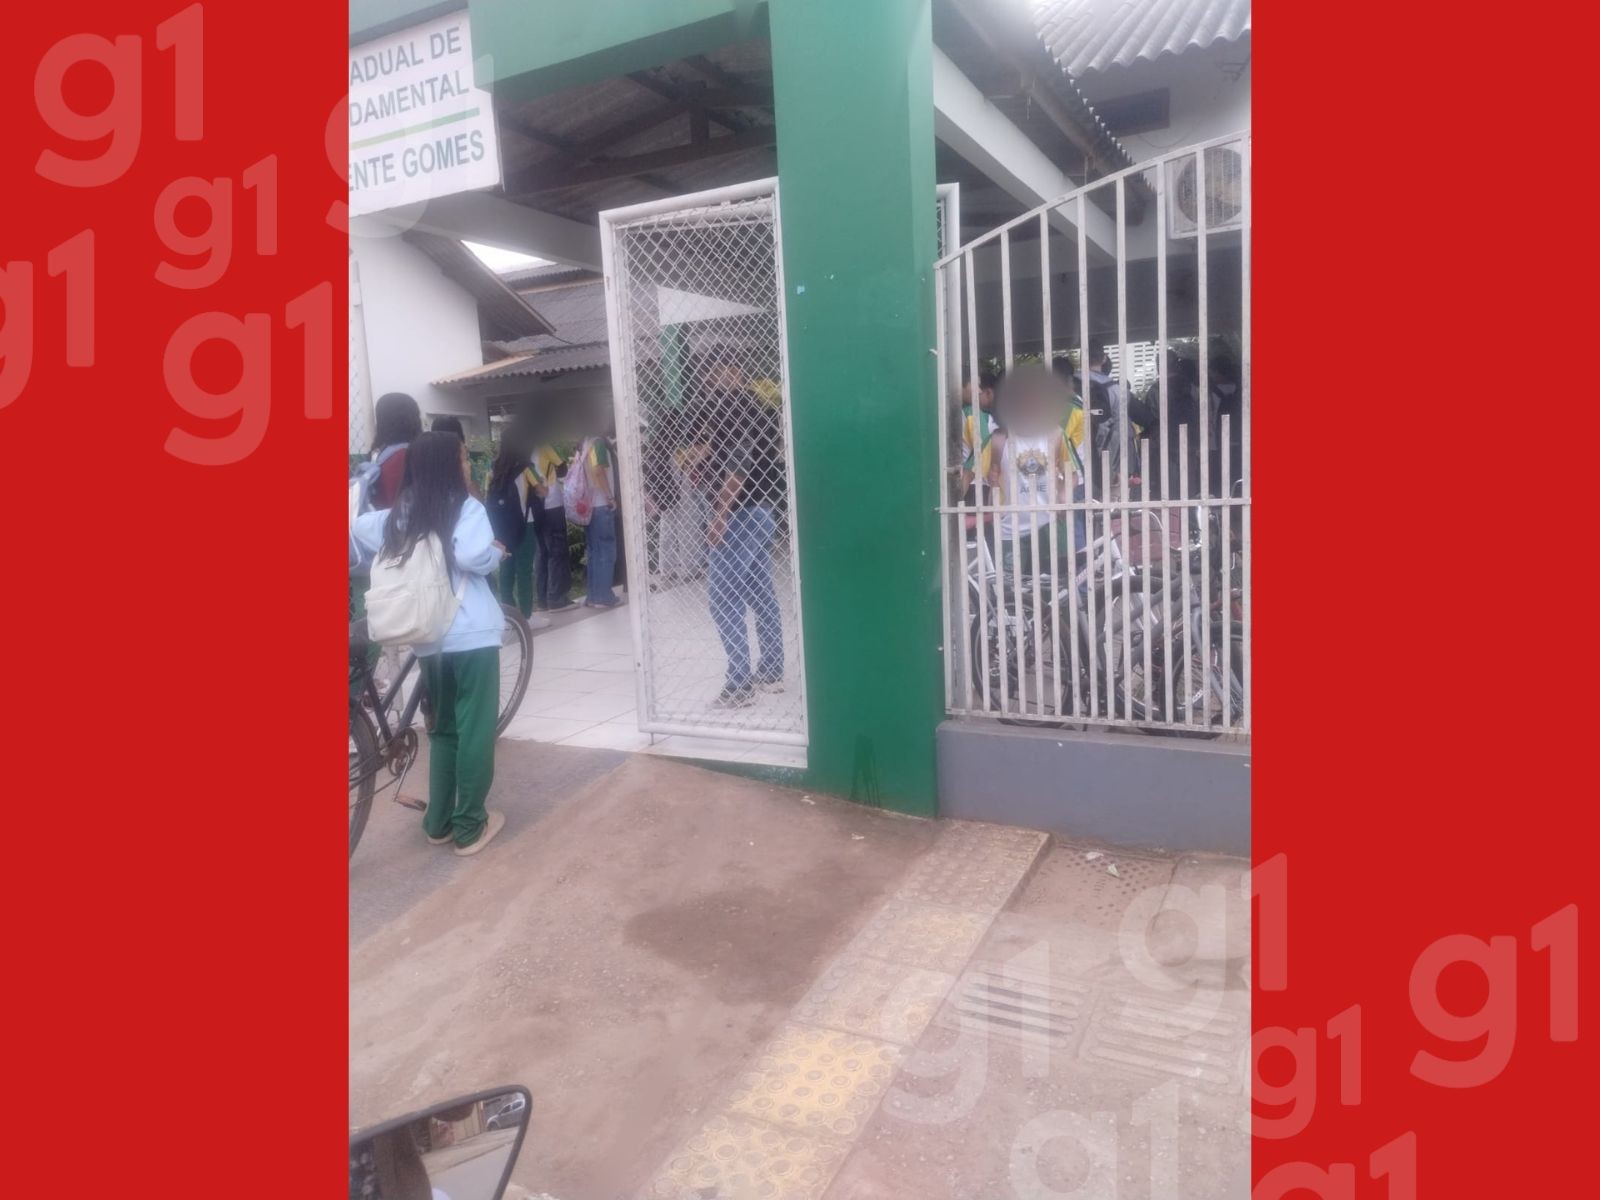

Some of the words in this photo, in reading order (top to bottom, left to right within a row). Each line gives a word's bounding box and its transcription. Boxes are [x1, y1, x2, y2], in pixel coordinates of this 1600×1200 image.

[350, 41, 424, 86] ADUAL
[430, 26, 462, 59] DE
[349, 70, 470, 127] DAMENTAL
[402, 129, 484, 178] GOMES
